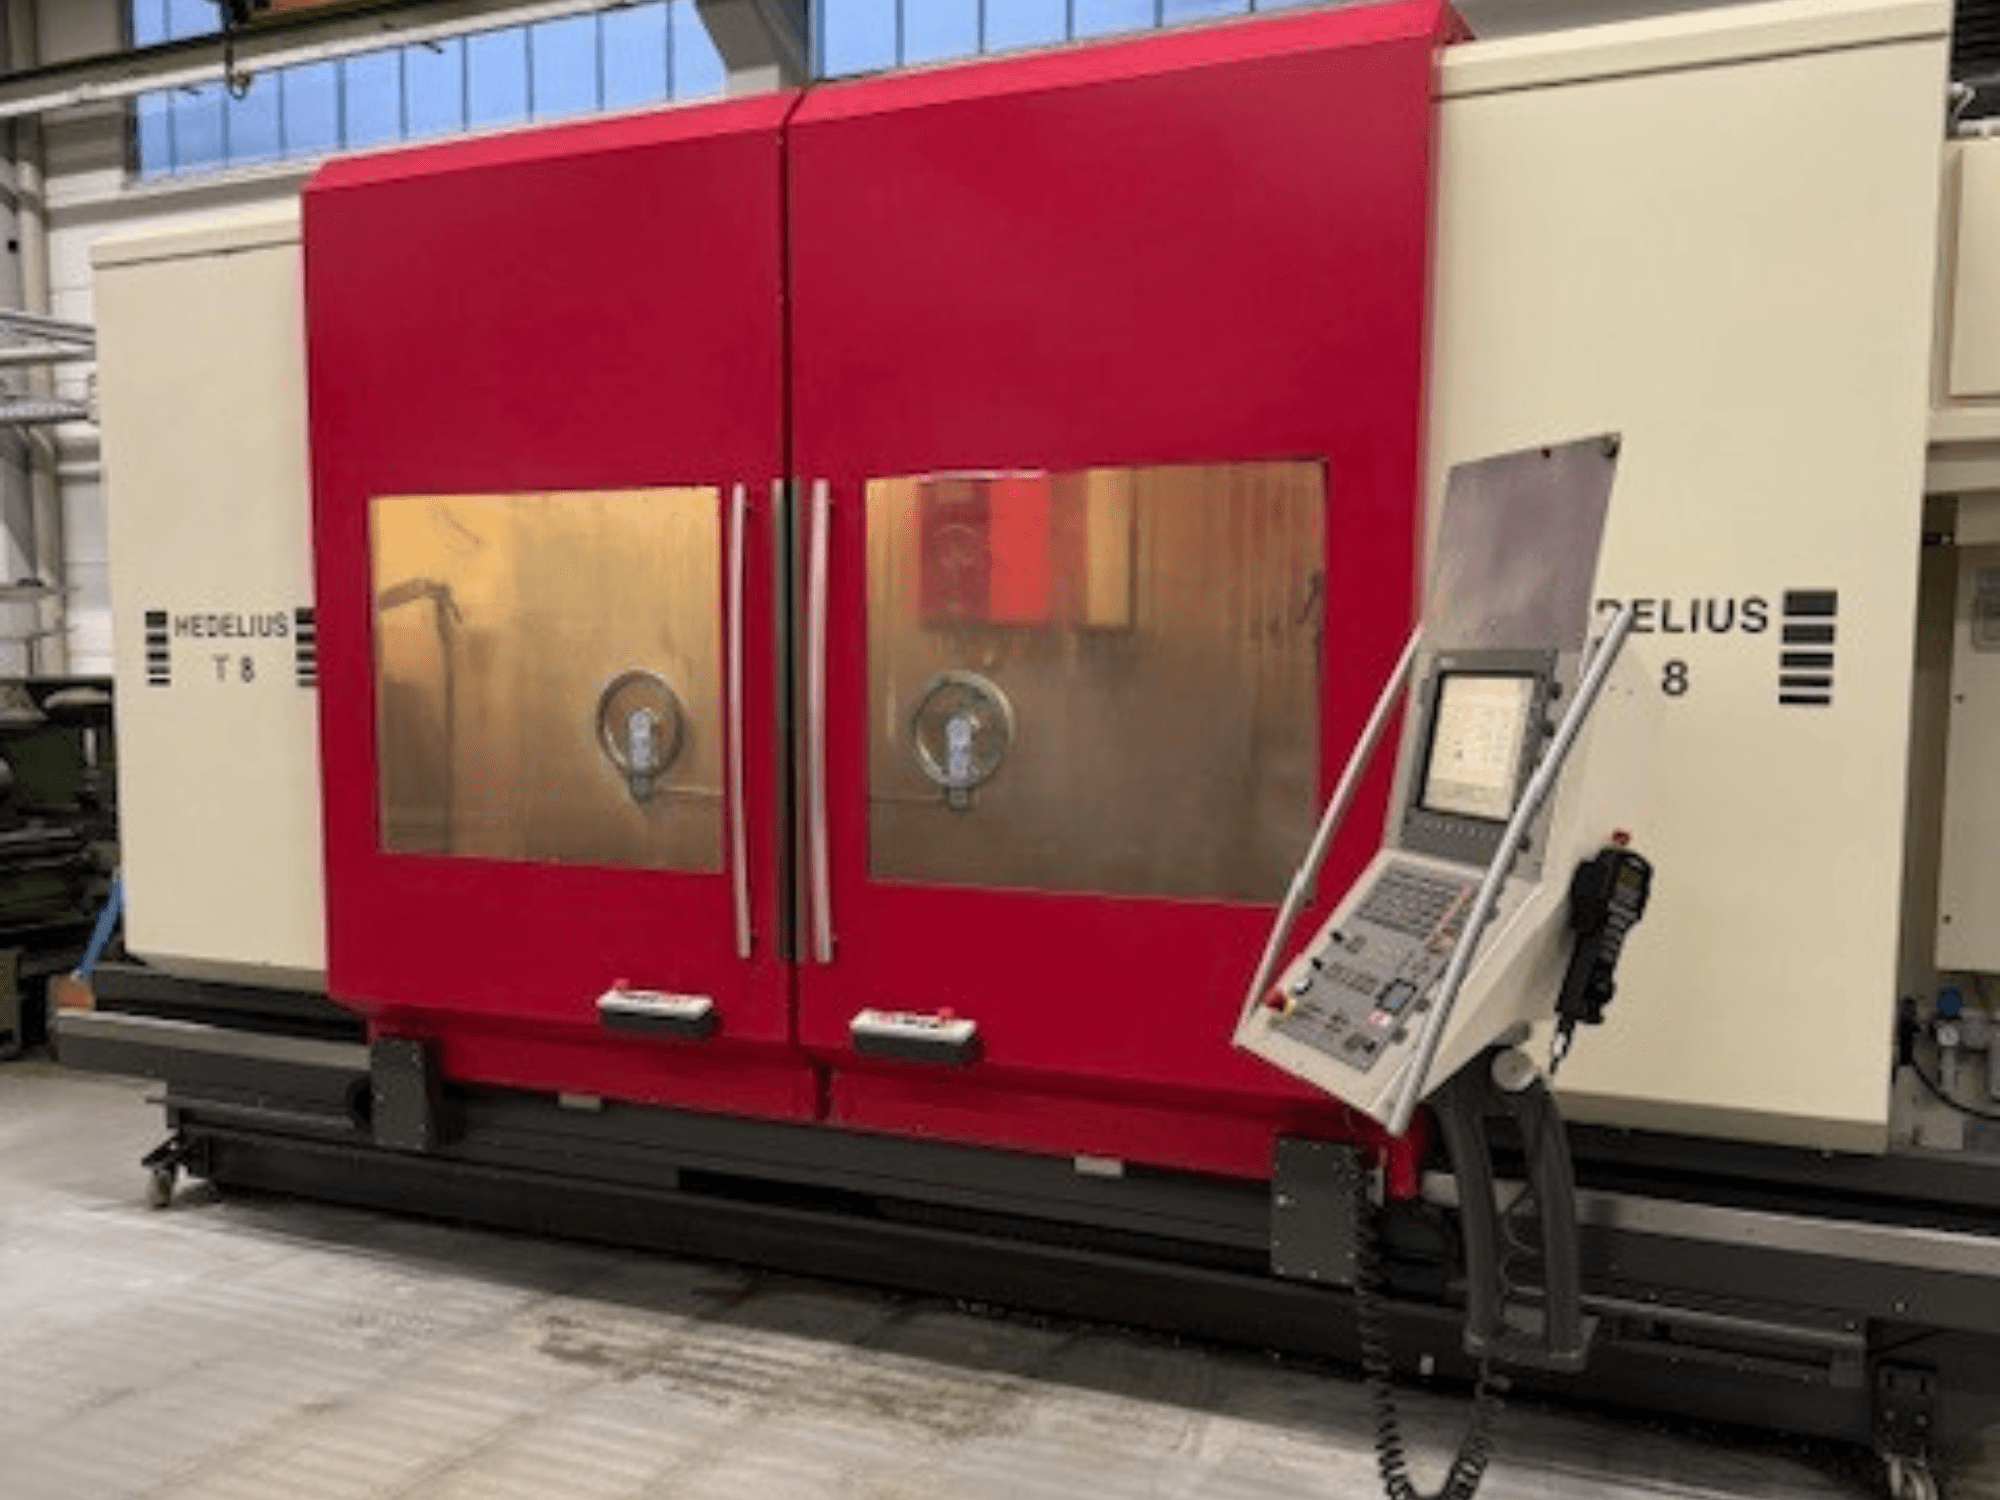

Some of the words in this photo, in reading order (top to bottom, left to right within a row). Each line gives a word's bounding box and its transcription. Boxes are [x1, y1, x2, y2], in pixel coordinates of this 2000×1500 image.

[174, 612, 288, 637] HEDELIUS
[213, 654, 230, 682] T
[240, 656, 255, 683] 8
[1661, 660, 1688, 696] 8
